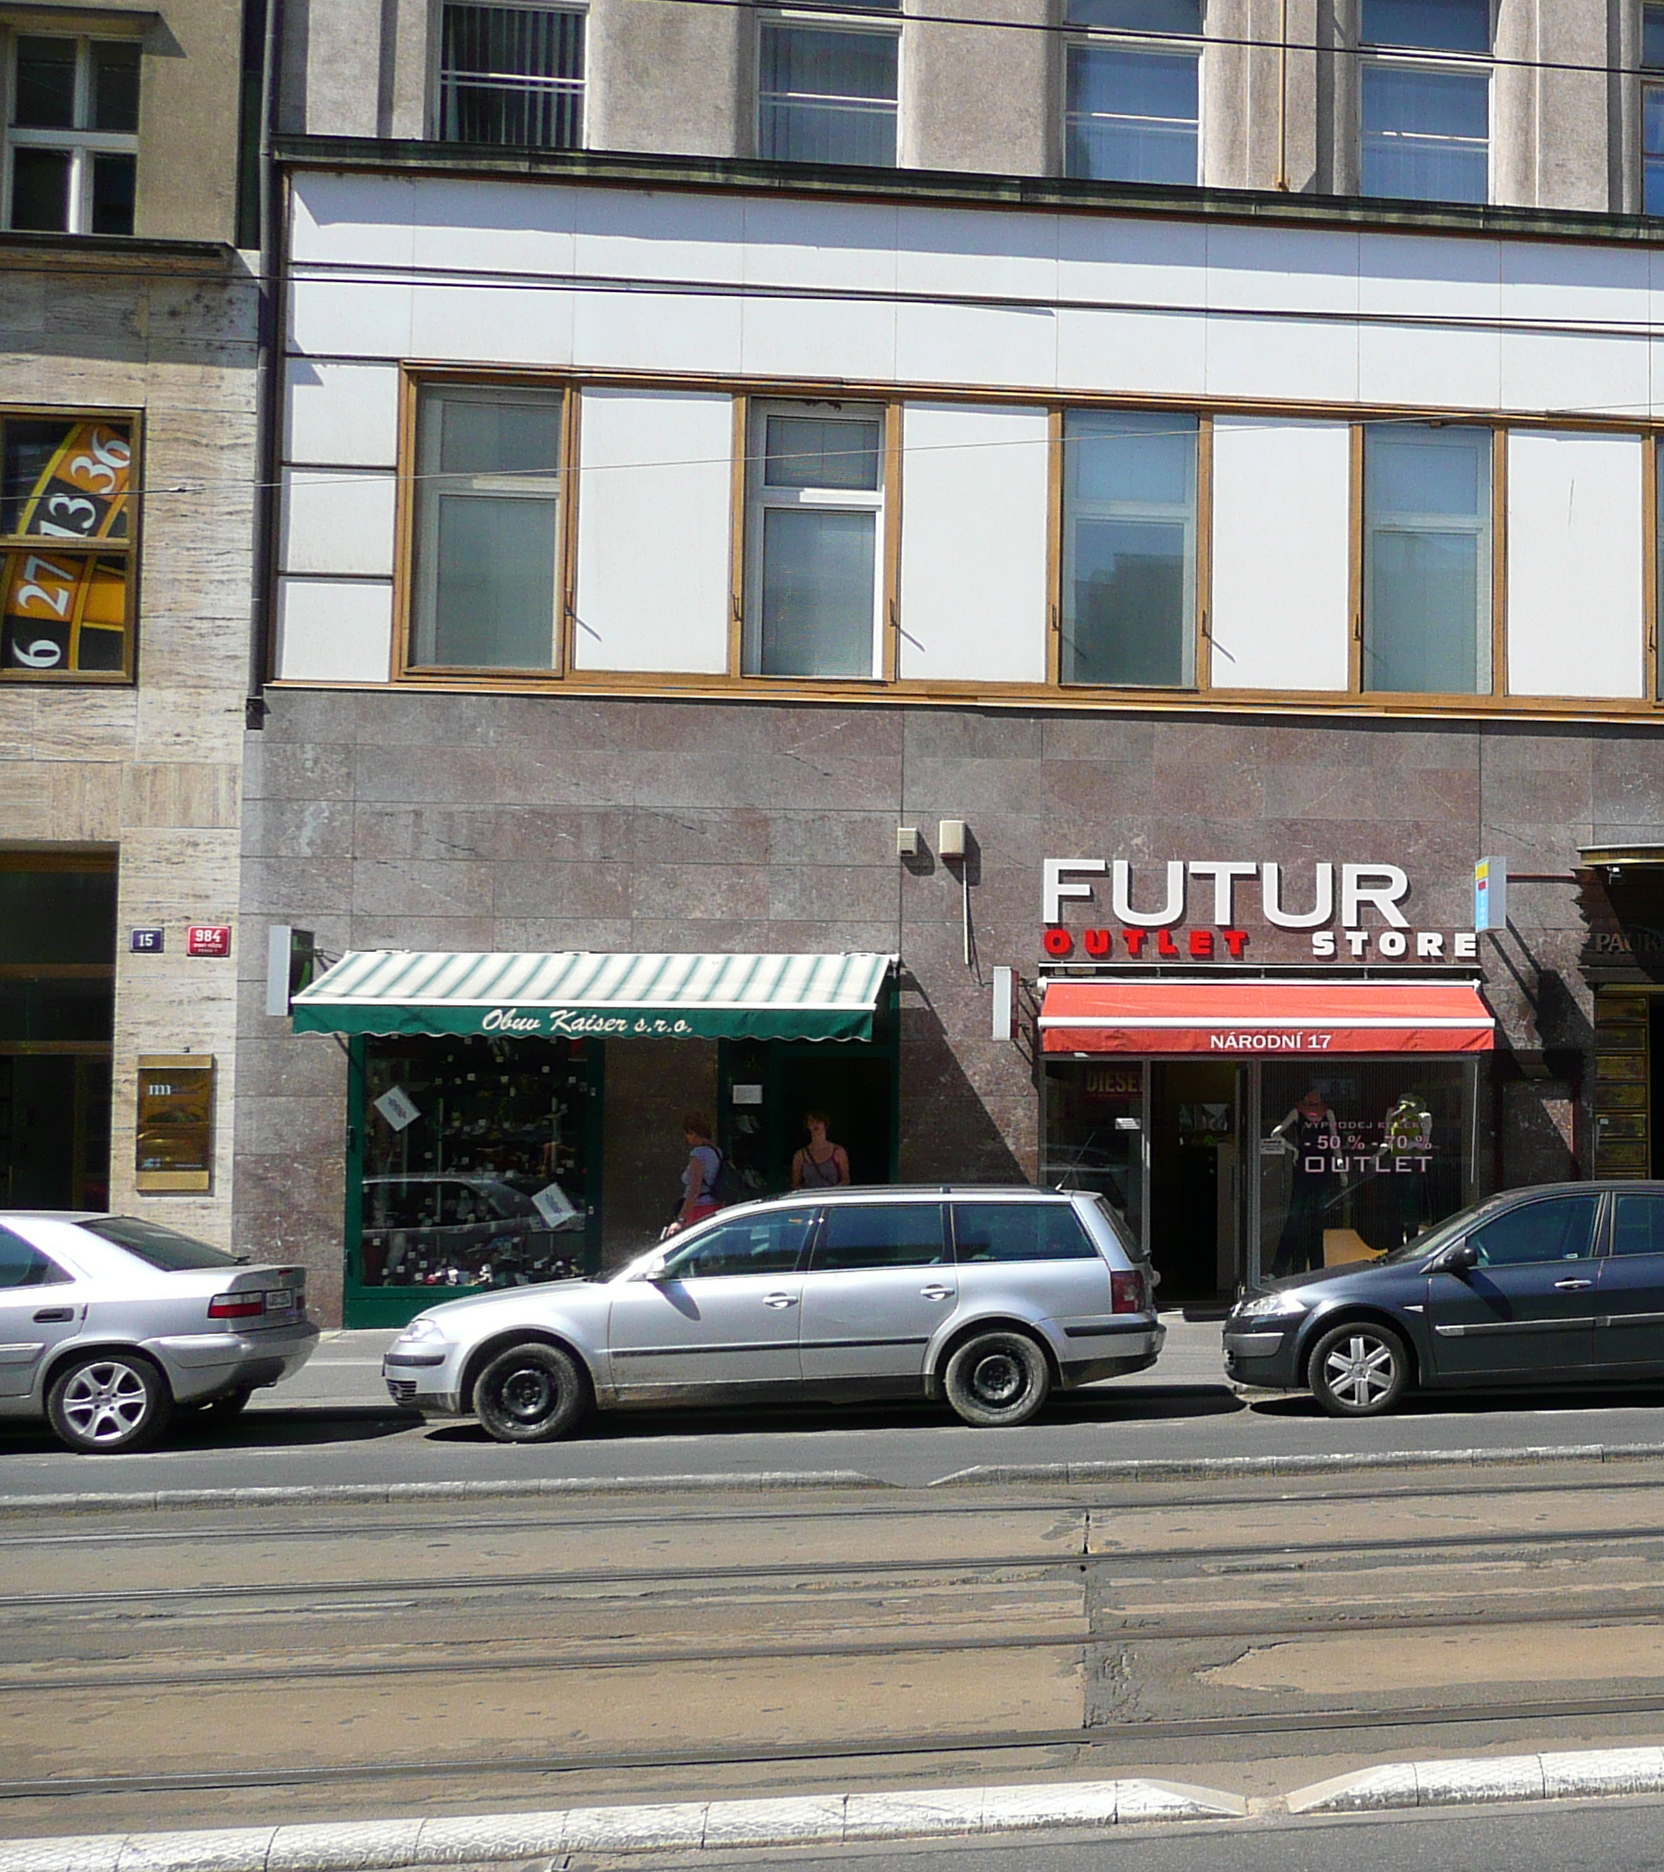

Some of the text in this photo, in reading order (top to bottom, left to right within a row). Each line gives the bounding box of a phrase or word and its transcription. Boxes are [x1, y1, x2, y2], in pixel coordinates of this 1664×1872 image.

[16, 554, 75, 618] 27
[1042, 858, 1410, 928] FUTUR
[139, 933, 153, 948] 15
[194, 929, 222, 943] 984
[1043, 929, 1248, 956] OUTLET
[1311, 931, 1478, 958] STORE
[482, 1008, 693, 1033] Obuv Kaiser s.r.o.
[1209, 1032, 1332, 1049] NÁRODNÍ 17
[1317, 1134, 1341, 1150] 50
[1347, 1133, 1366, 1151] %
[1384, 1135, 1408, 1150] 70
[1415, 1135, 1433, 1151] %
[1304, 1155, 1434, 1174] OUTLET
